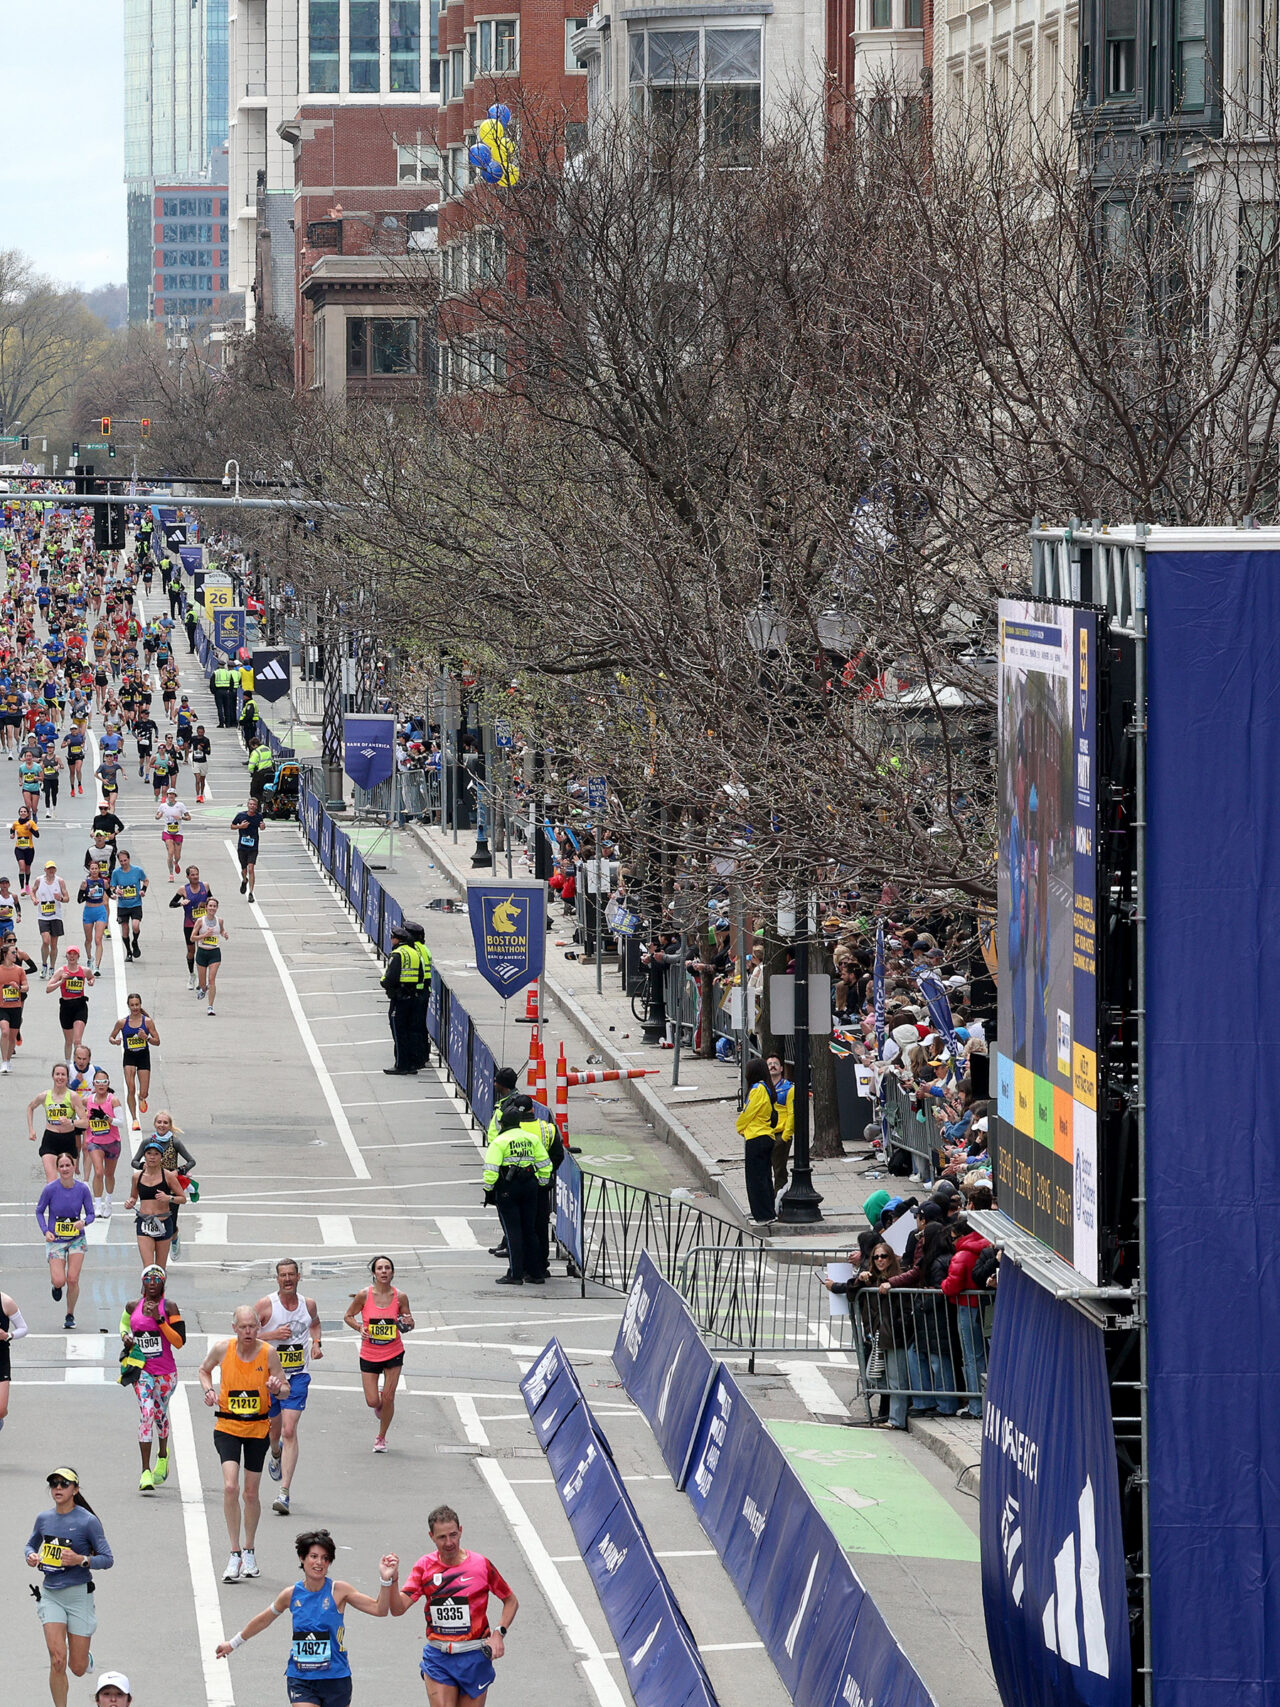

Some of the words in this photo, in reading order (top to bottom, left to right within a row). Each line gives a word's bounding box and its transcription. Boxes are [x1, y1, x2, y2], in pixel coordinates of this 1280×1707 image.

[209, 592, 228, 604] 26
[486, 935, 526, 945] BOSTON
[487, 945, 526, 953] MARATHON
[278, 1352, 303, 1362] 17850
[229, 1397, 259, 1410] 21212
[43, 1545, 63, 1561] 1740
[436, 1606, 464, 1622] 9335
[295, 1641, 329, 1657] 14927
